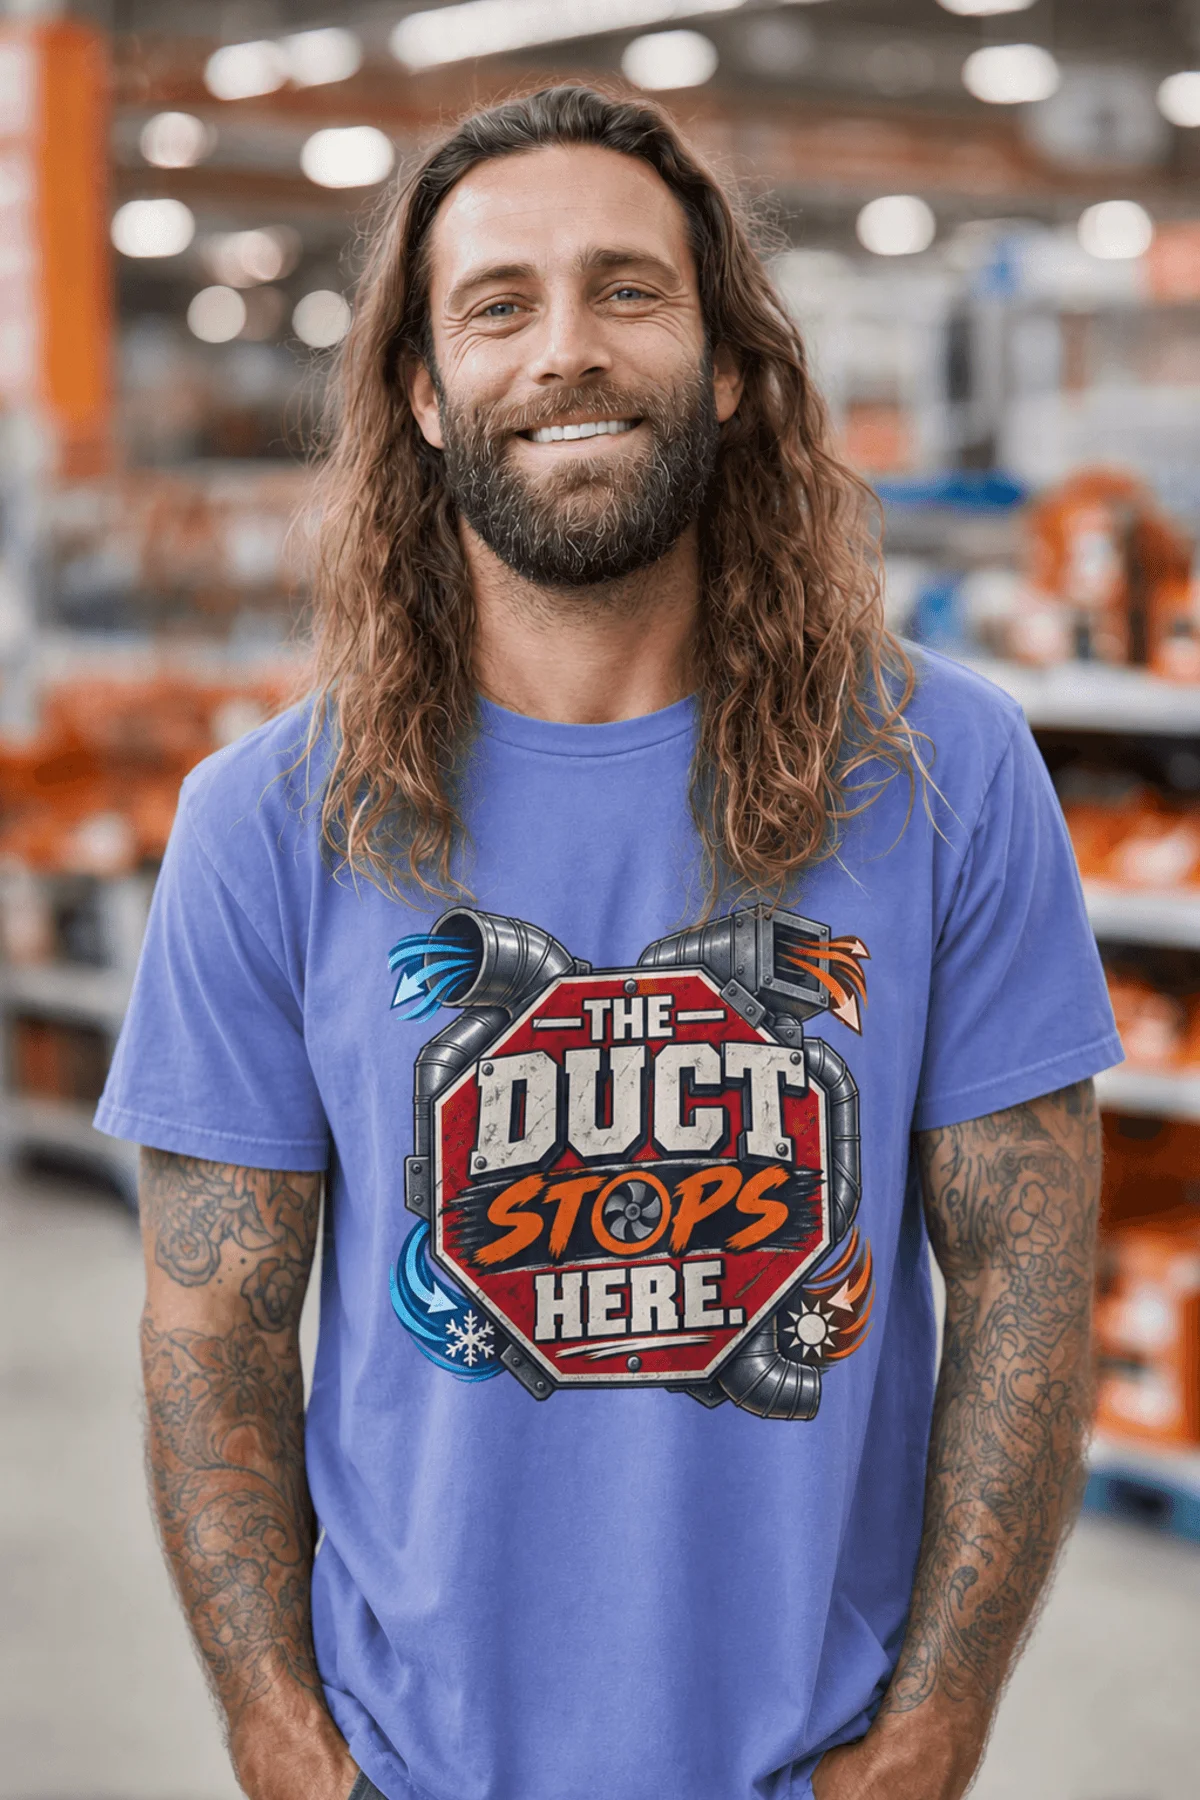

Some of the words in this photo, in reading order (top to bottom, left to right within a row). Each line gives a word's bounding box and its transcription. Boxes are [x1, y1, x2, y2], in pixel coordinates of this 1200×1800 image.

[584, 995, 673, 1041] THE
[470, 1042, 806, 1176] DUCT
[469, 1164, 791, 1266] STOPS
[533, 1260, 744, 1341] HERE.
